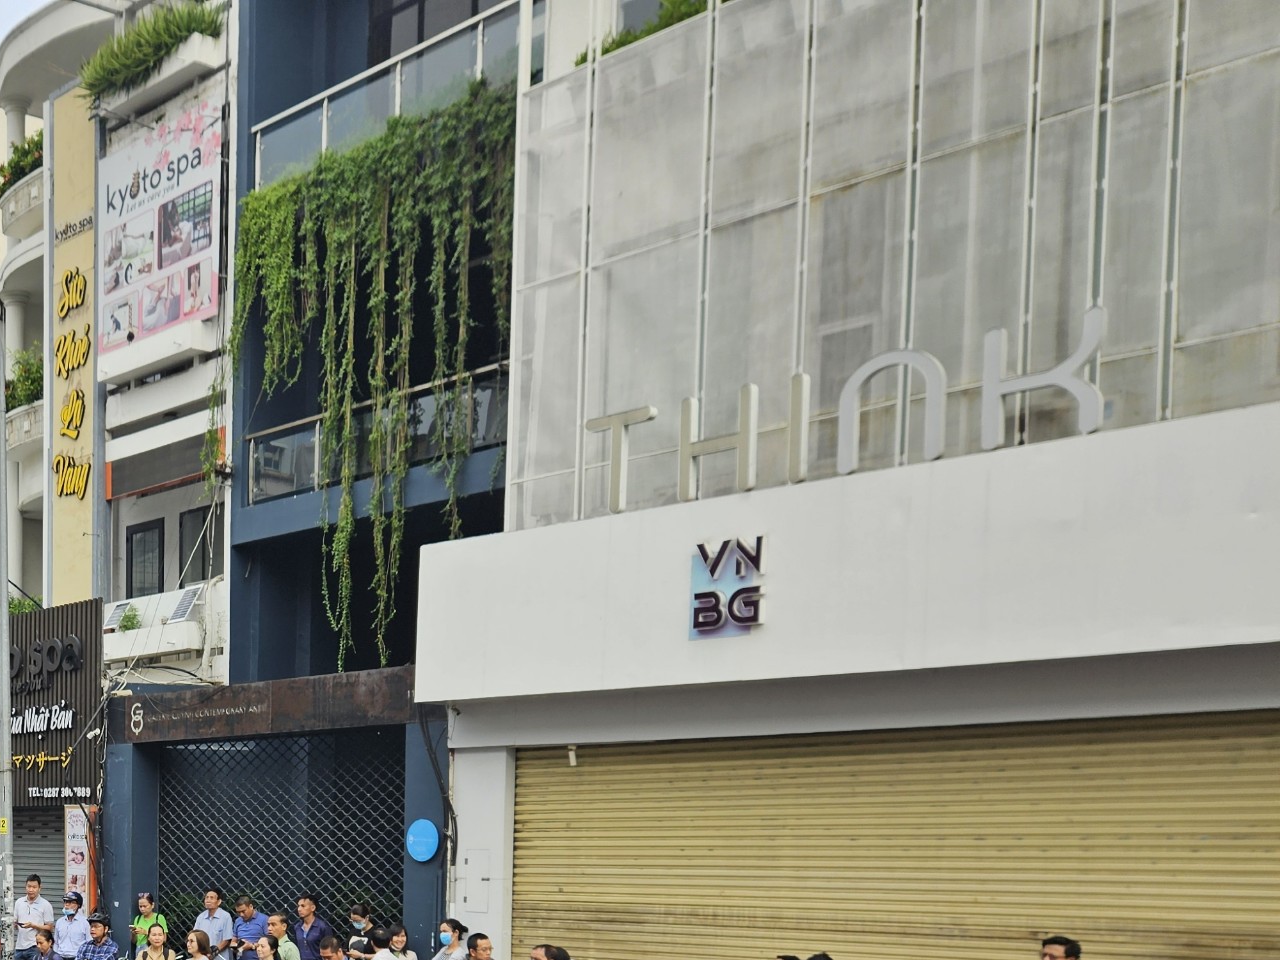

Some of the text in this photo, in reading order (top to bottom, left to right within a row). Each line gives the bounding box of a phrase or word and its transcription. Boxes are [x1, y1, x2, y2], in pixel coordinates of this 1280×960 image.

[106, 147, 201, 217] kyoto spa
[52, 455, 91, 501] Vàng
[696, 535, 766, 580] VN
[692, 585, 765, 632] BG
[29, 634, 82, 688] spa
[10, 708, 23, 735] ủa
[23, 707, 50, 740] Nhật
[50, 699, 74, 731] Bản
[28, 786, 43, 798] TEL:
[43, 787, 60, 799] 0287
